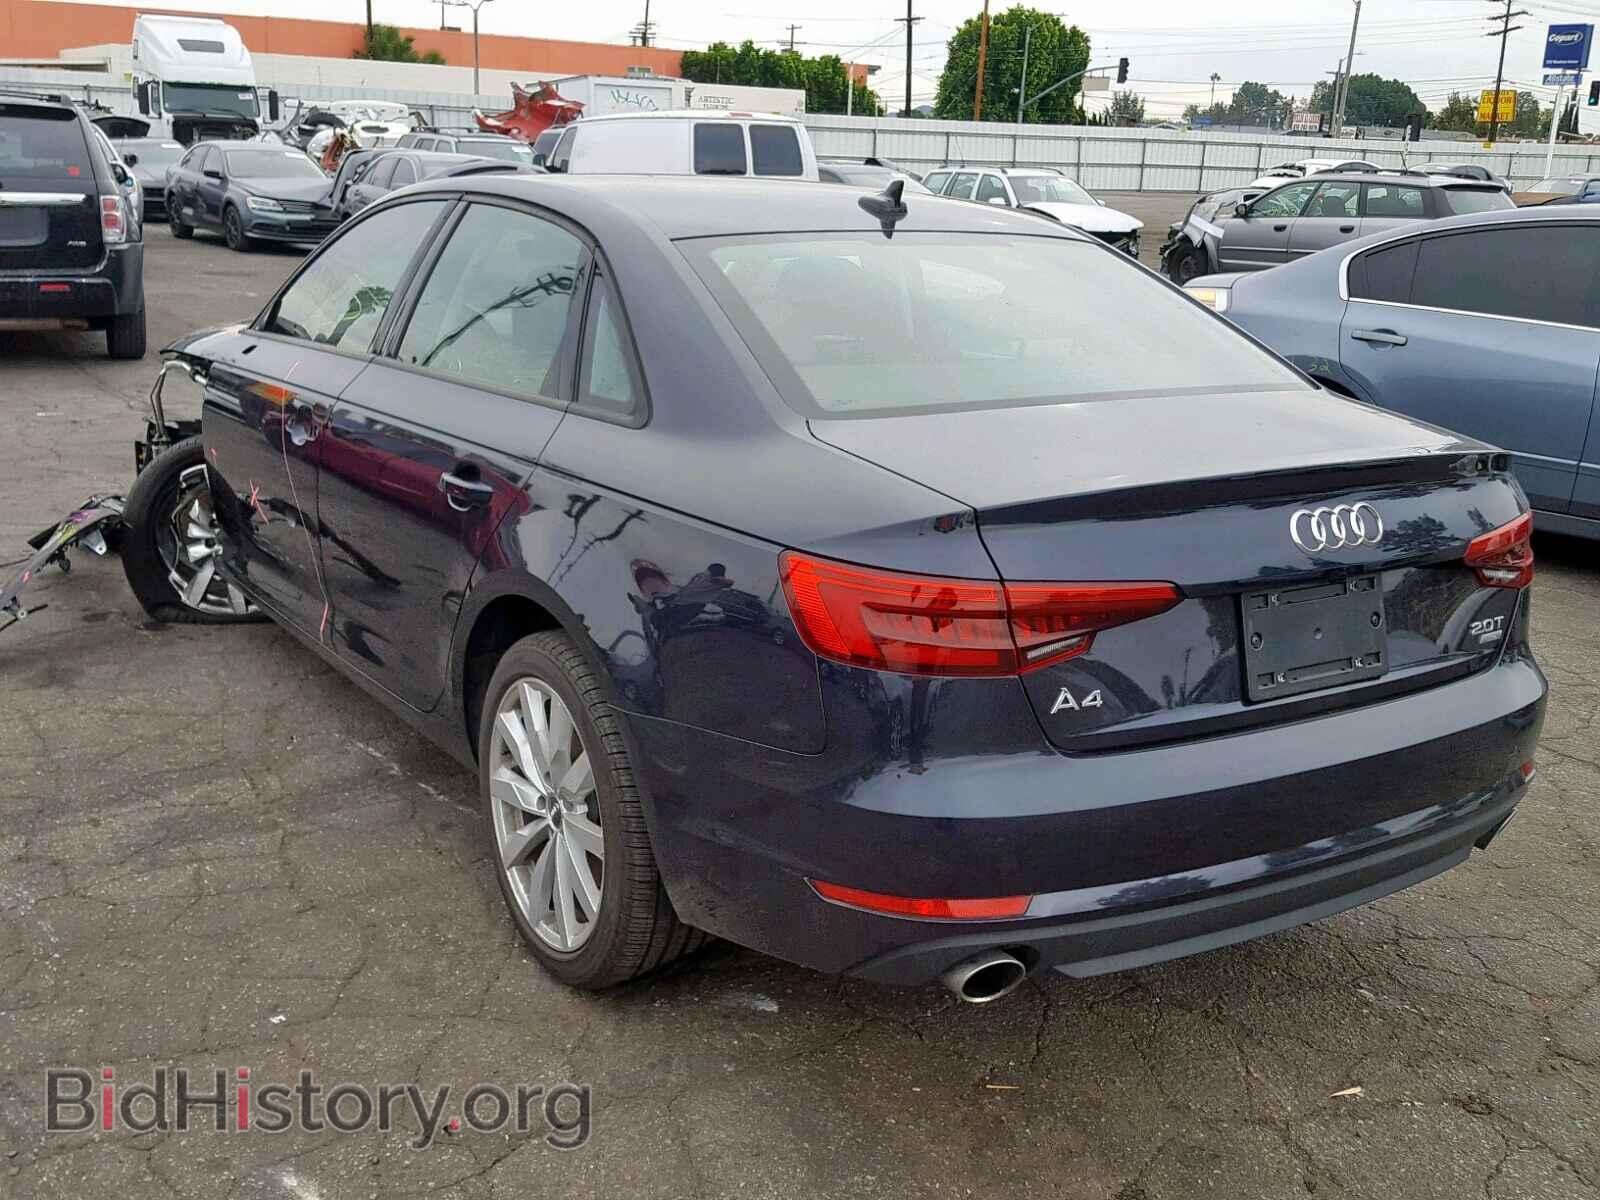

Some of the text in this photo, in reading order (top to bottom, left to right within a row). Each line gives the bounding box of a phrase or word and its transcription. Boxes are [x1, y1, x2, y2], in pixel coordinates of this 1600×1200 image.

[1549, 33, 1580, 43] Copart
[1481, 95, 1513, 104] LIQOR
[1050, 687, 1103, 714] A4
